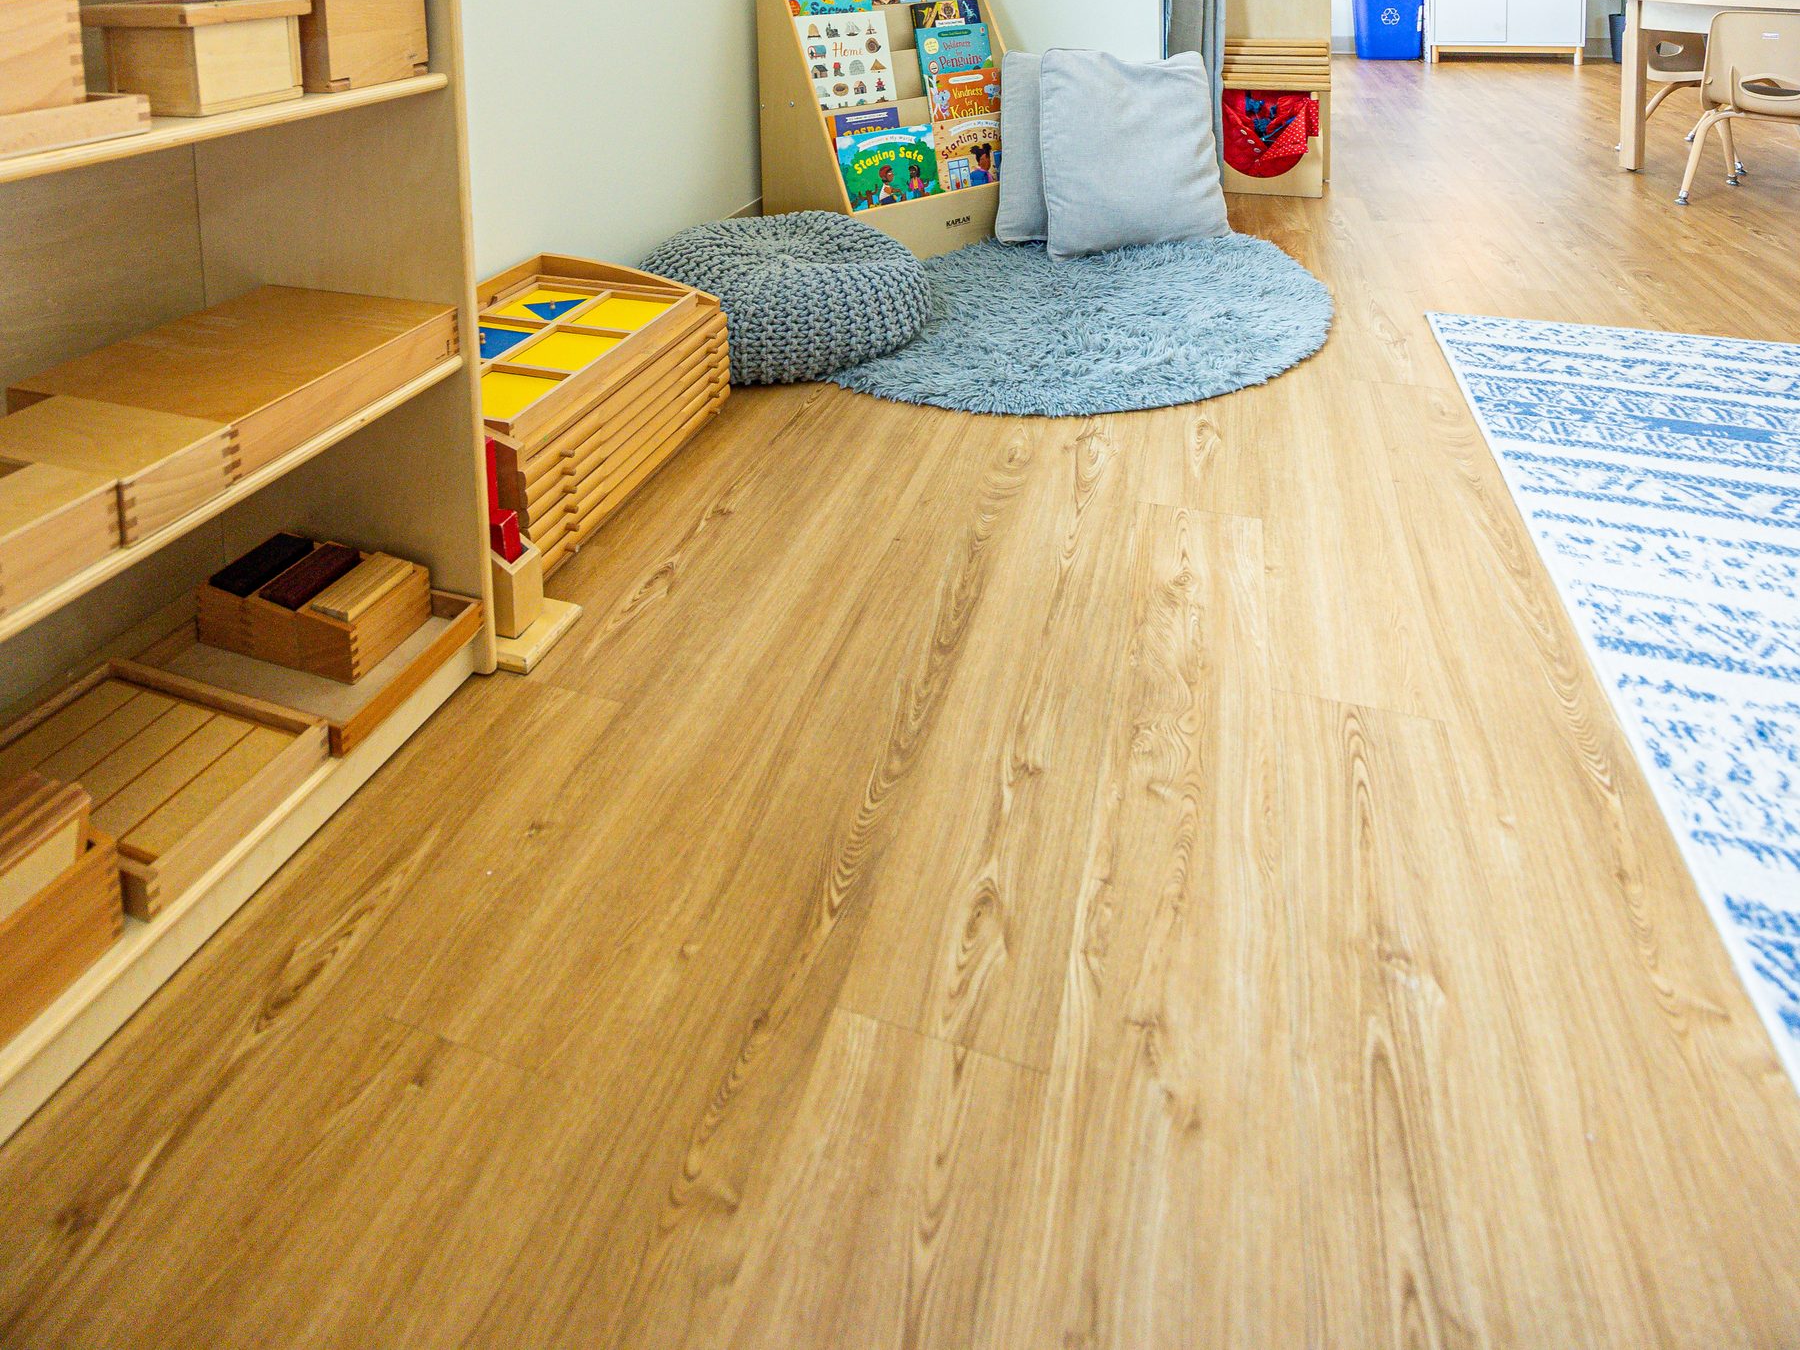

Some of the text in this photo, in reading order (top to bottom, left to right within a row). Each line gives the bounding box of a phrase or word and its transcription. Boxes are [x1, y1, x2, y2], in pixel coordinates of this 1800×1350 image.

[832, 42, 864, 57] Home
[938, 54, 983, 69] Penguins
[952, 85, 983, 99] Kindness
[950, 102, 991, 119] Koalas
[941, 132, 979, 159] Starting
[853, 147, 924, 174] Staying Safe
[946, 215, 971, 227] KAPLAN
